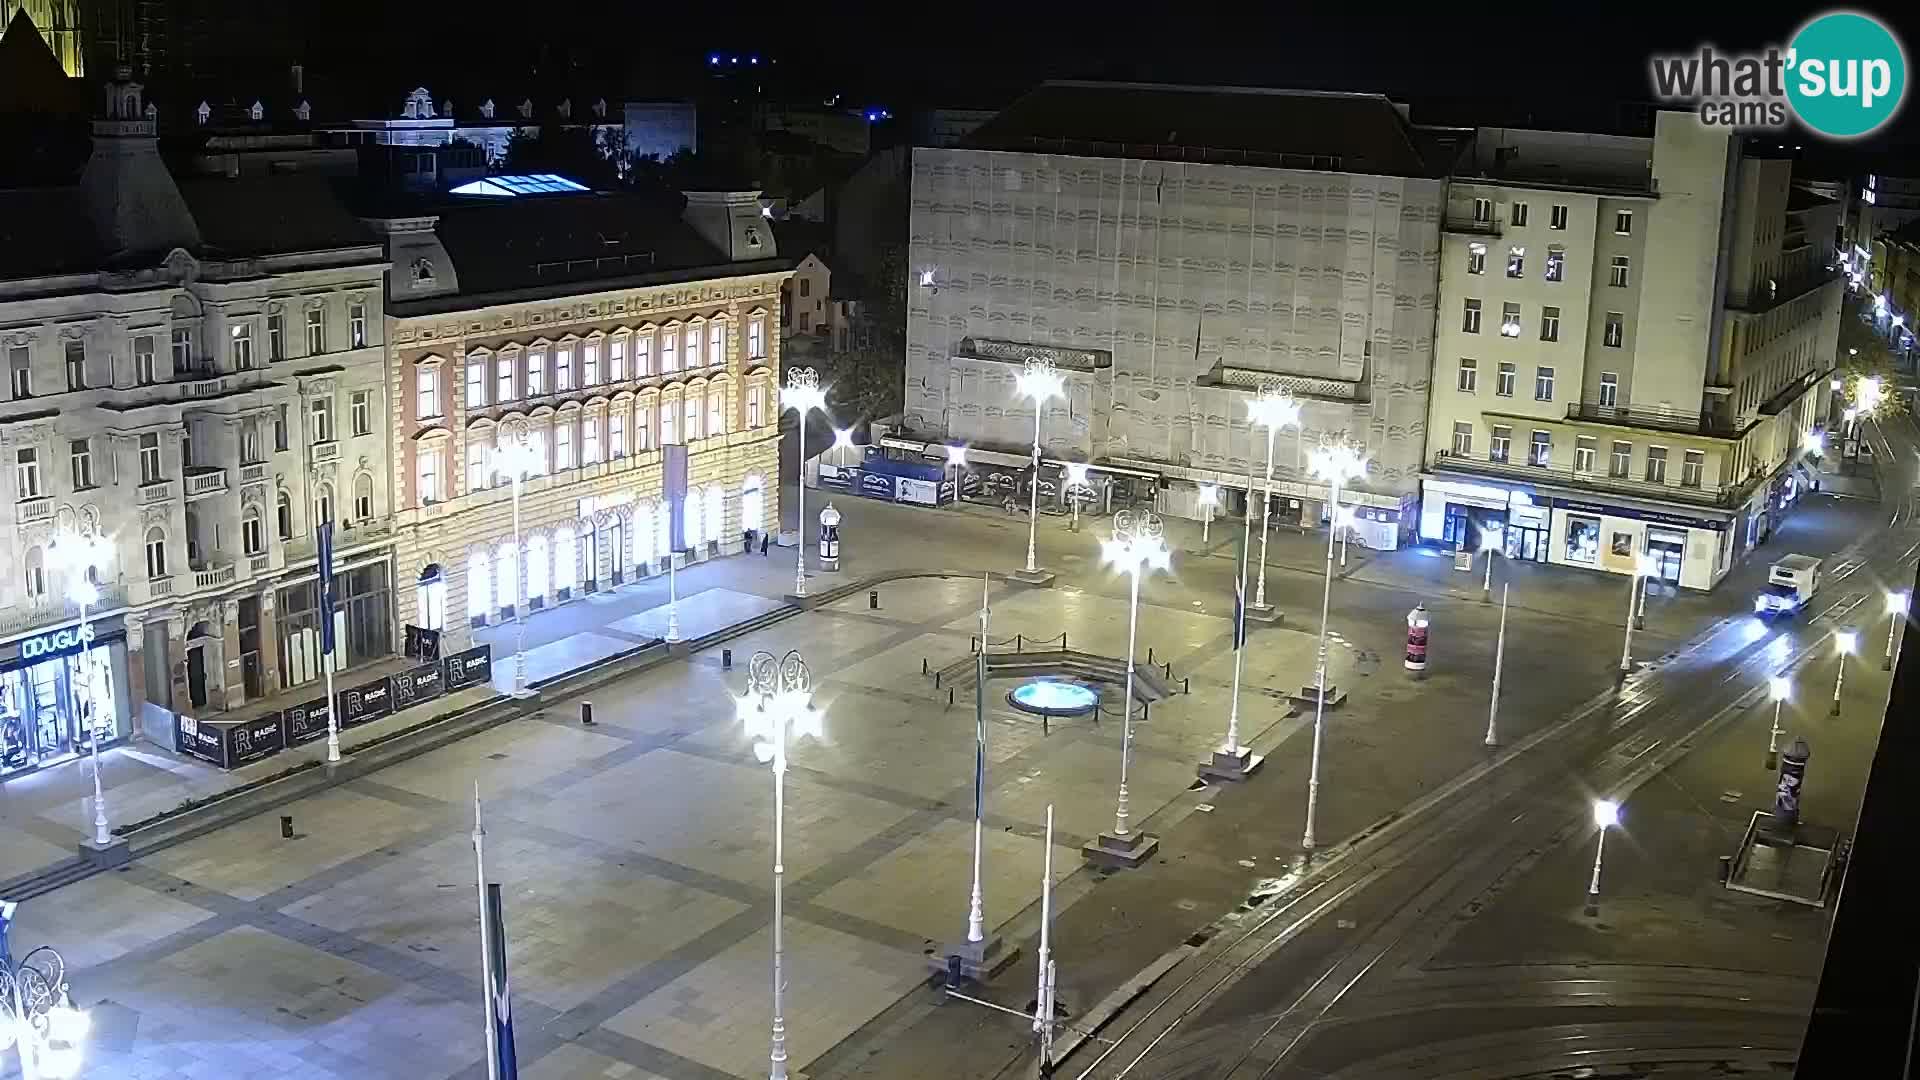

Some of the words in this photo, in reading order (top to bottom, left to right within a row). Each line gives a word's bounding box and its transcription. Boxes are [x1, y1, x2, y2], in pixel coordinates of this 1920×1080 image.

[22, 623, 95, 659] DOUGLAS
[450, 658, 464, 682] R
[400, 675, 415, 697] R
[347, 691, 363, 715] R
[292, 709, 307, 733] R
[235, 728, 252, 754] R
